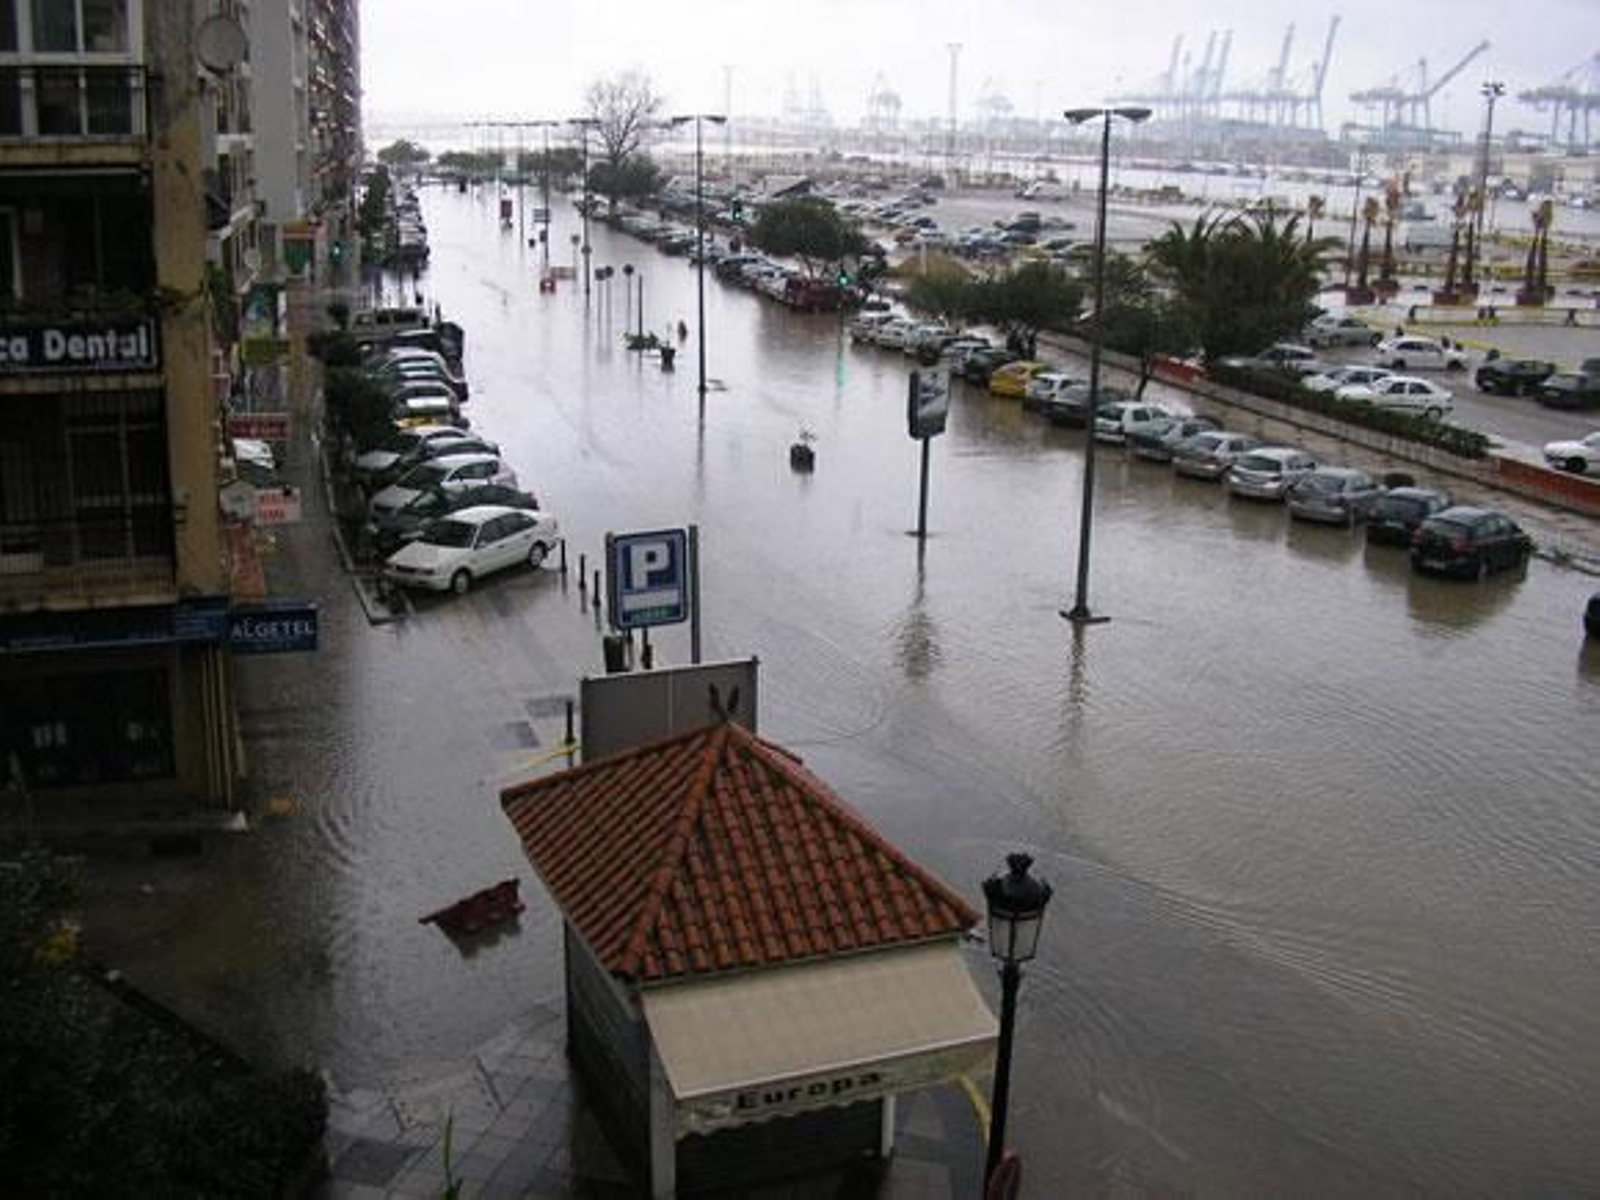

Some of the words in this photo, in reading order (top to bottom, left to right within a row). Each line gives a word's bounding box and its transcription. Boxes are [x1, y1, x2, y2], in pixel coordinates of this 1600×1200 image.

[43, 324, 149, 361] Dental
[630, 542, 670, 589] P
[737, 1072, 881, 1108] Europa
